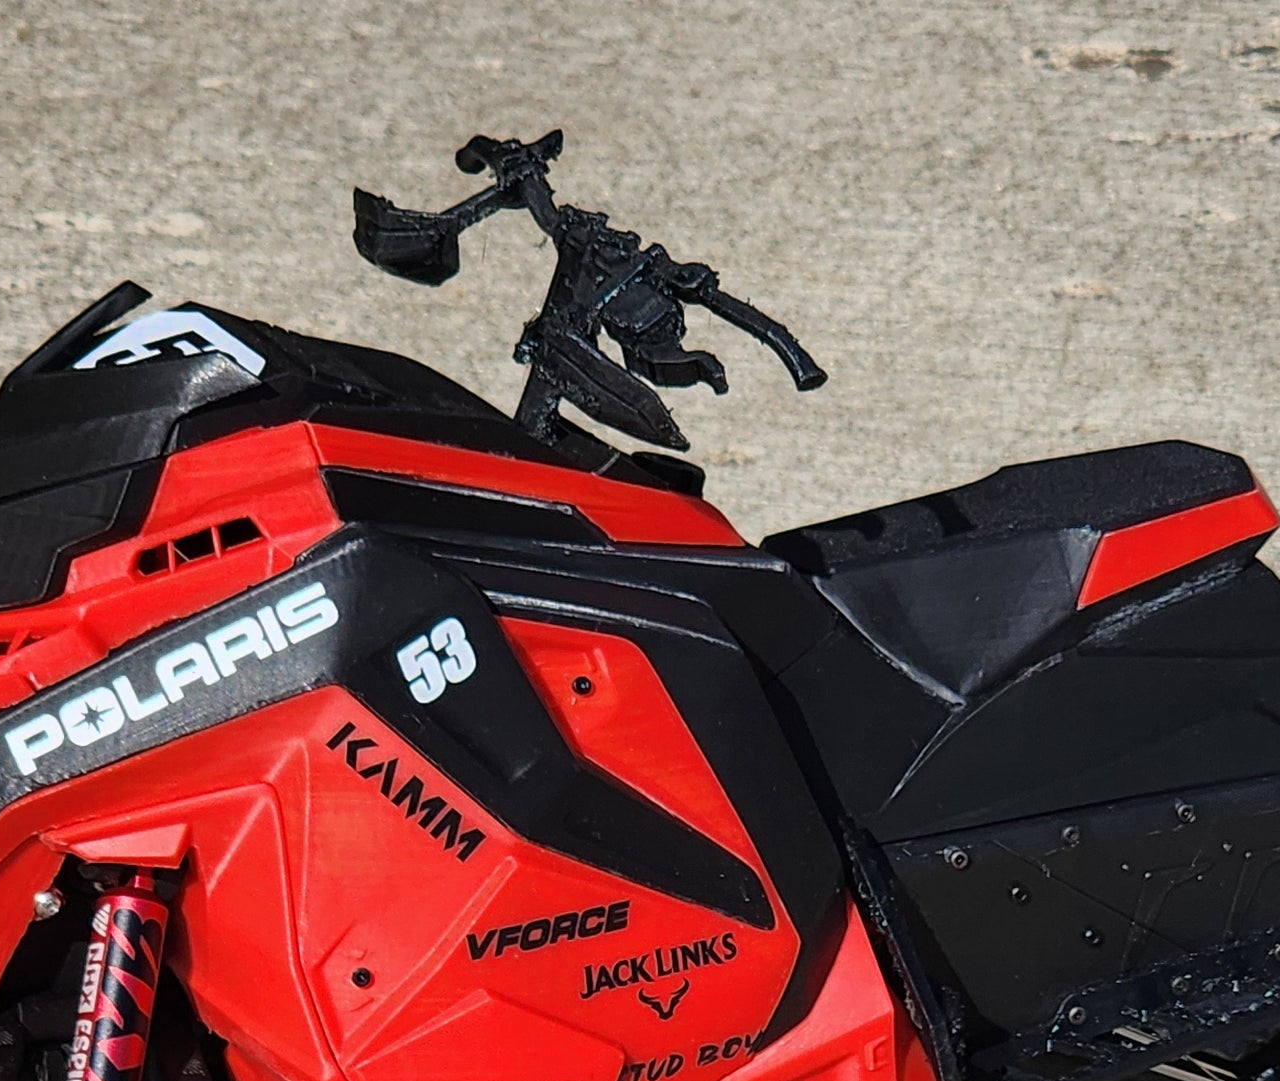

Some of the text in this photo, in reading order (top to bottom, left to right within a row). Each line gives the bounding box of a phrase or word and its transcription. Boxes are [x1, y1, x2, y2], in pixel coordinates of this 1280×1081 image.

[4, 581, 340, 776] POLARIS
[396, 617, 478, 704] 53
[325, 721, 487, 862] KAMM
[466, 900, 631, 961] VFORCE
[580, 932, 738, 999] JACK LINKS
